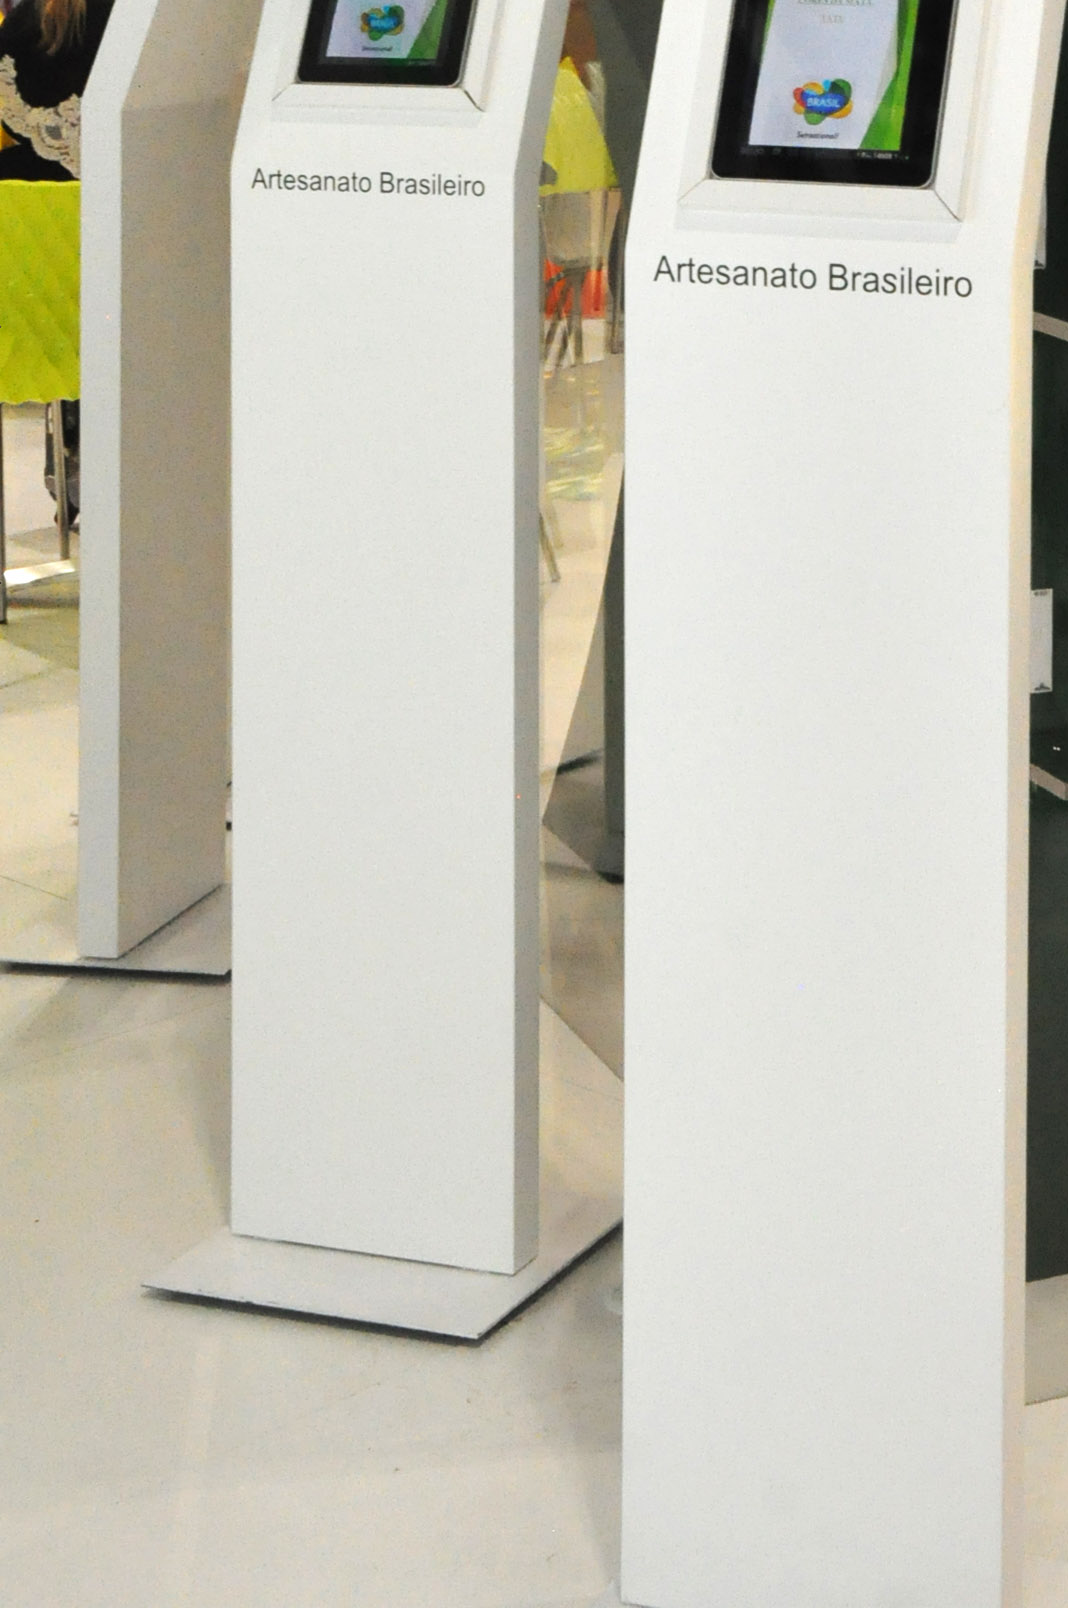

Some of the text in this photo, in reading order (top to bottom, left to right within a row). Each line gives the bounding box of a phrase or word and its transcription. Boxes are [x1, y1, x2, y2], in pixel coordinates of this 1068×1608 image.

[806, 97, 841, 108] BRASIL
[251, 167, 486, 197] Artesanato Brasileiro
[653, 255, 974, 298] Artesanato Brasileiro
